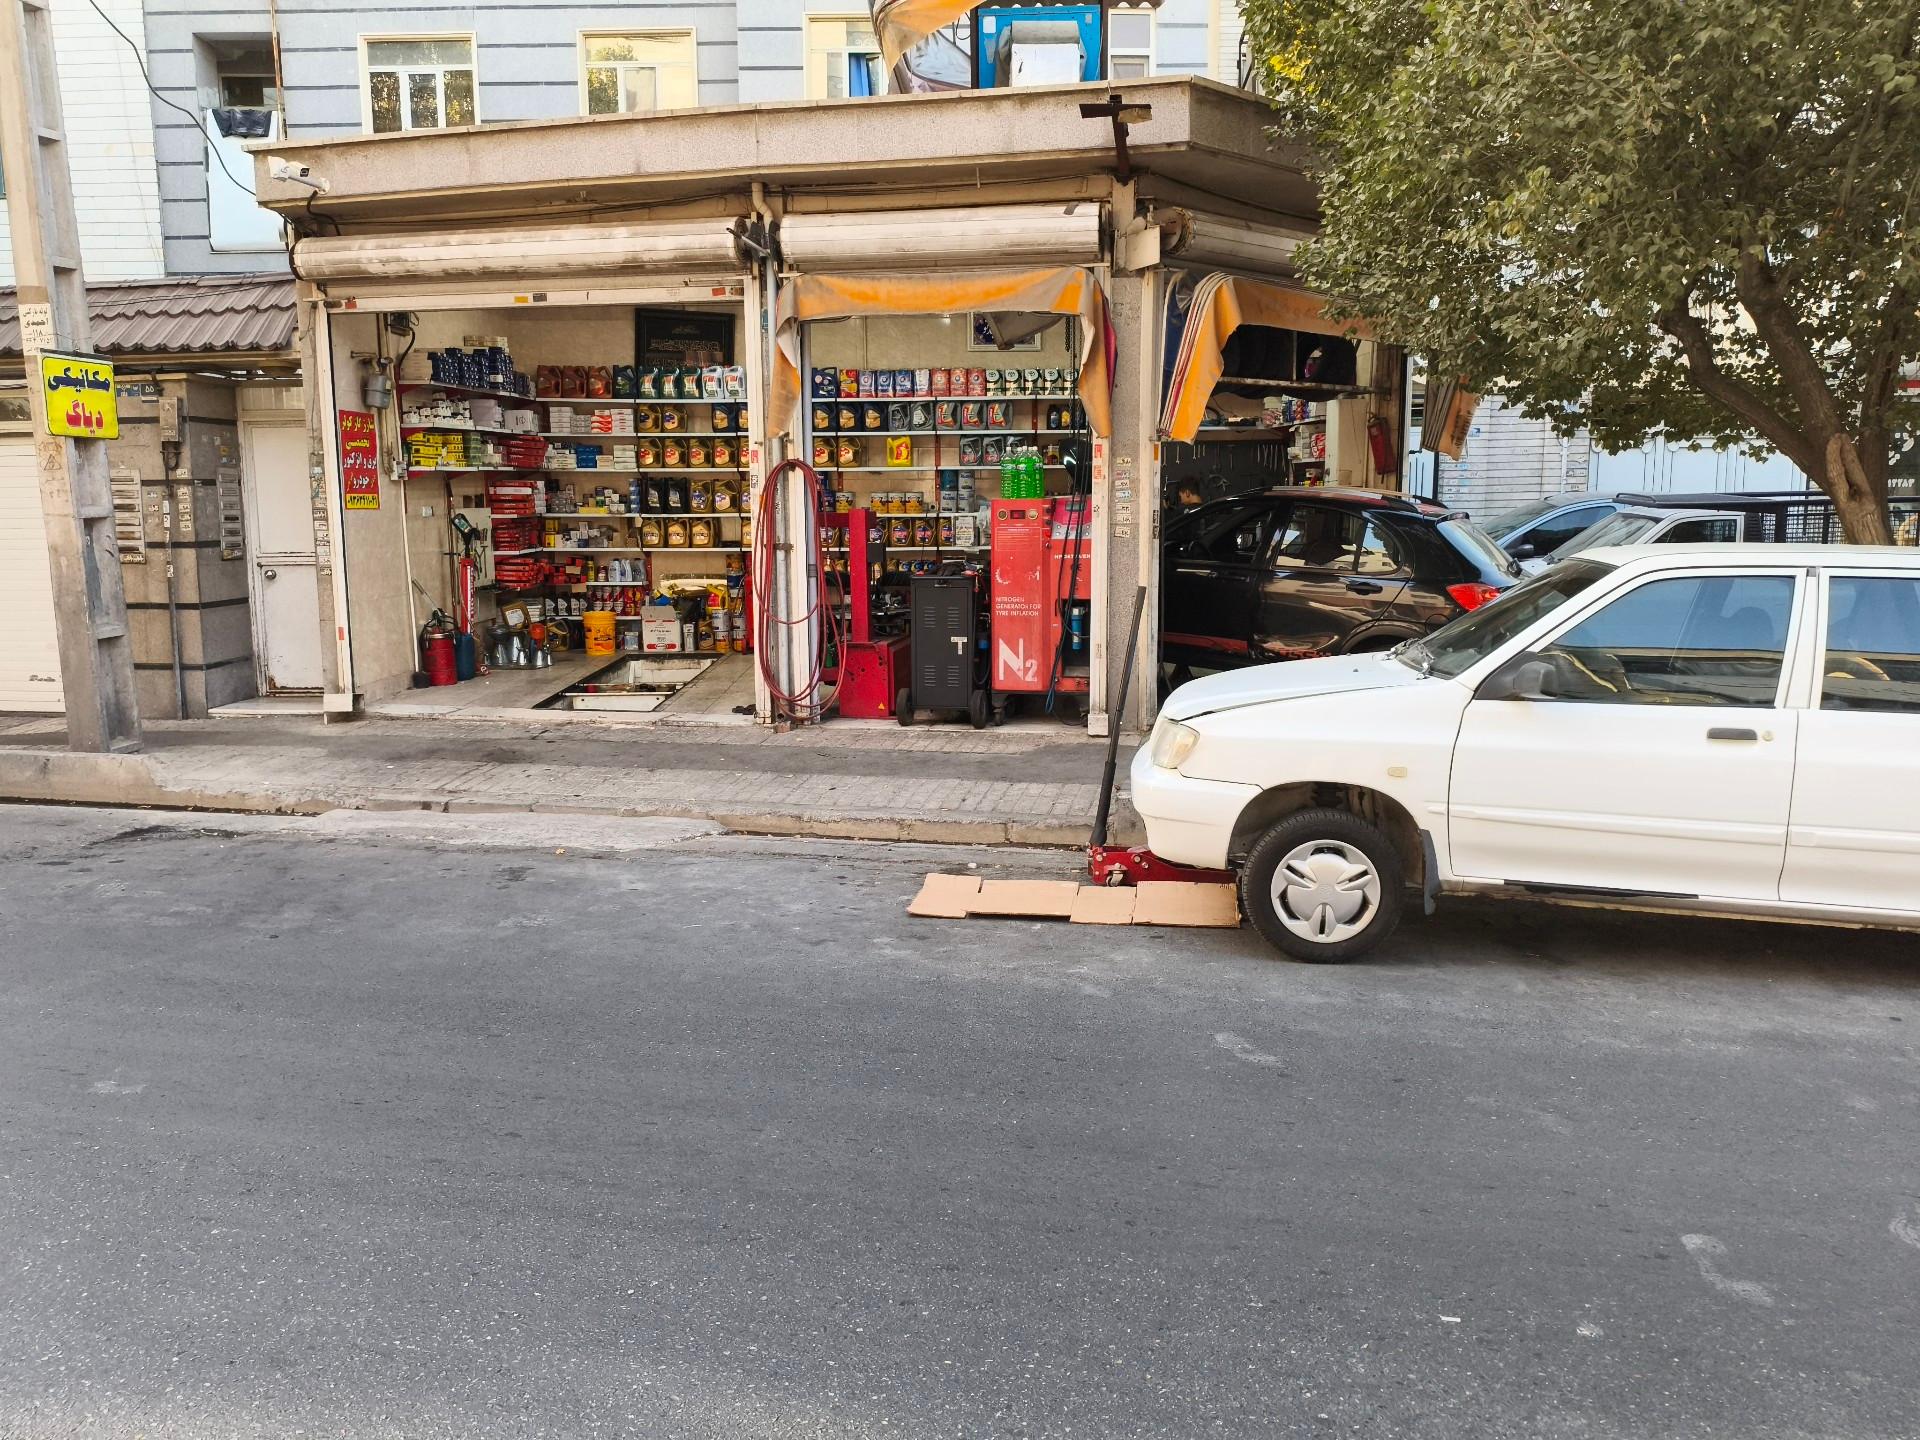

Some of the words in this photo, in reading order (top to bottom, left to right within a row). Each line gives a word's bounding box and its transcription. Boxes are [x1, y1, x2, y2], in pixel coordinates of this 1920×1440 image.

[47, 366, 111, 393] مکانیکی
[66, 400, 104, 435] دیاگ
[353, 472, 370, 489] خودرو
[998, 637, 1039, 682] N2
